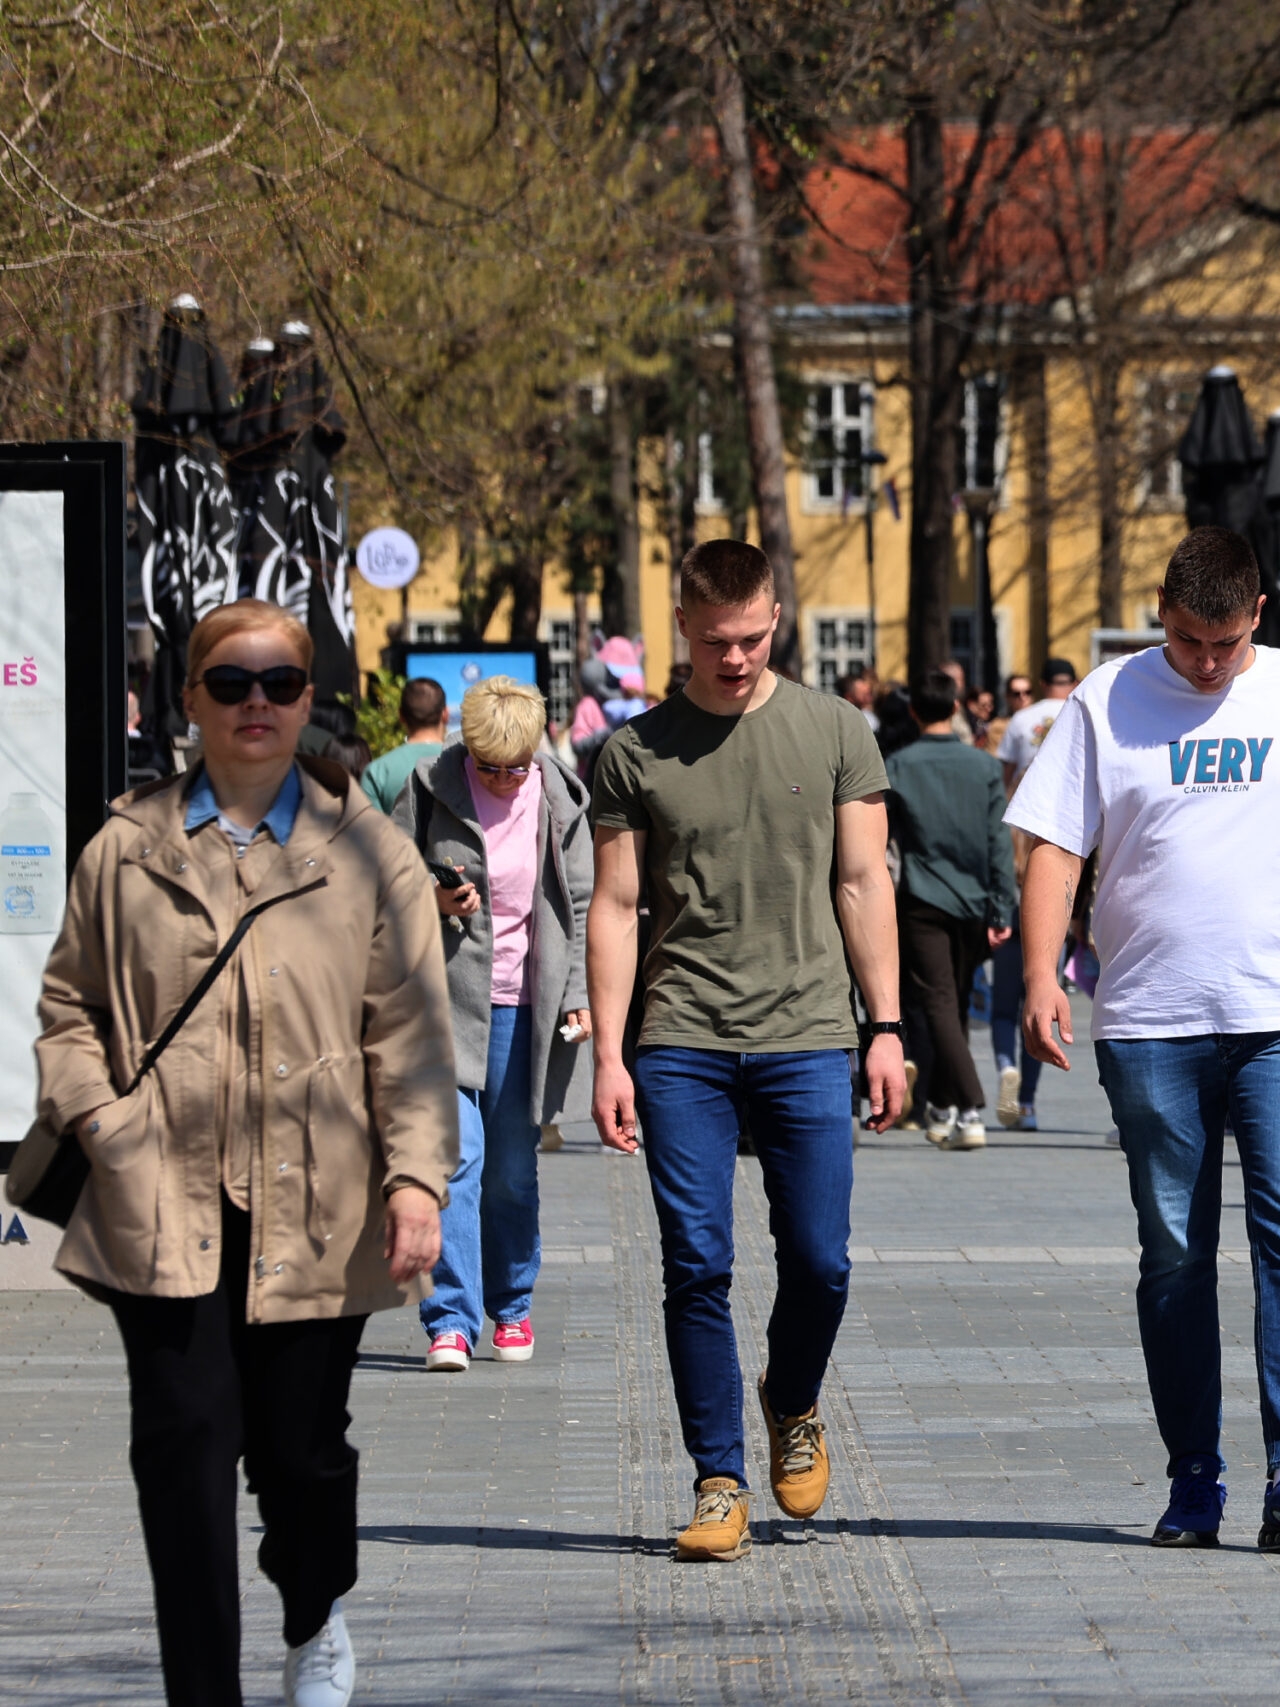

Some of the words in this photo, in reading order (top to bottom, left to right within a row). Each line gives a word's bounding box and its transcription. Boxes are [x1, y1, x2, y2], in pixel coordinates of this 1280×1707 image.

[4, 656, 38, 686] EŠ
[1168, 737, 1274, 786] VERY
[1183, 785, 1219, 795] CALVIN
[1221, 784, 1250, 793] KLEIN
